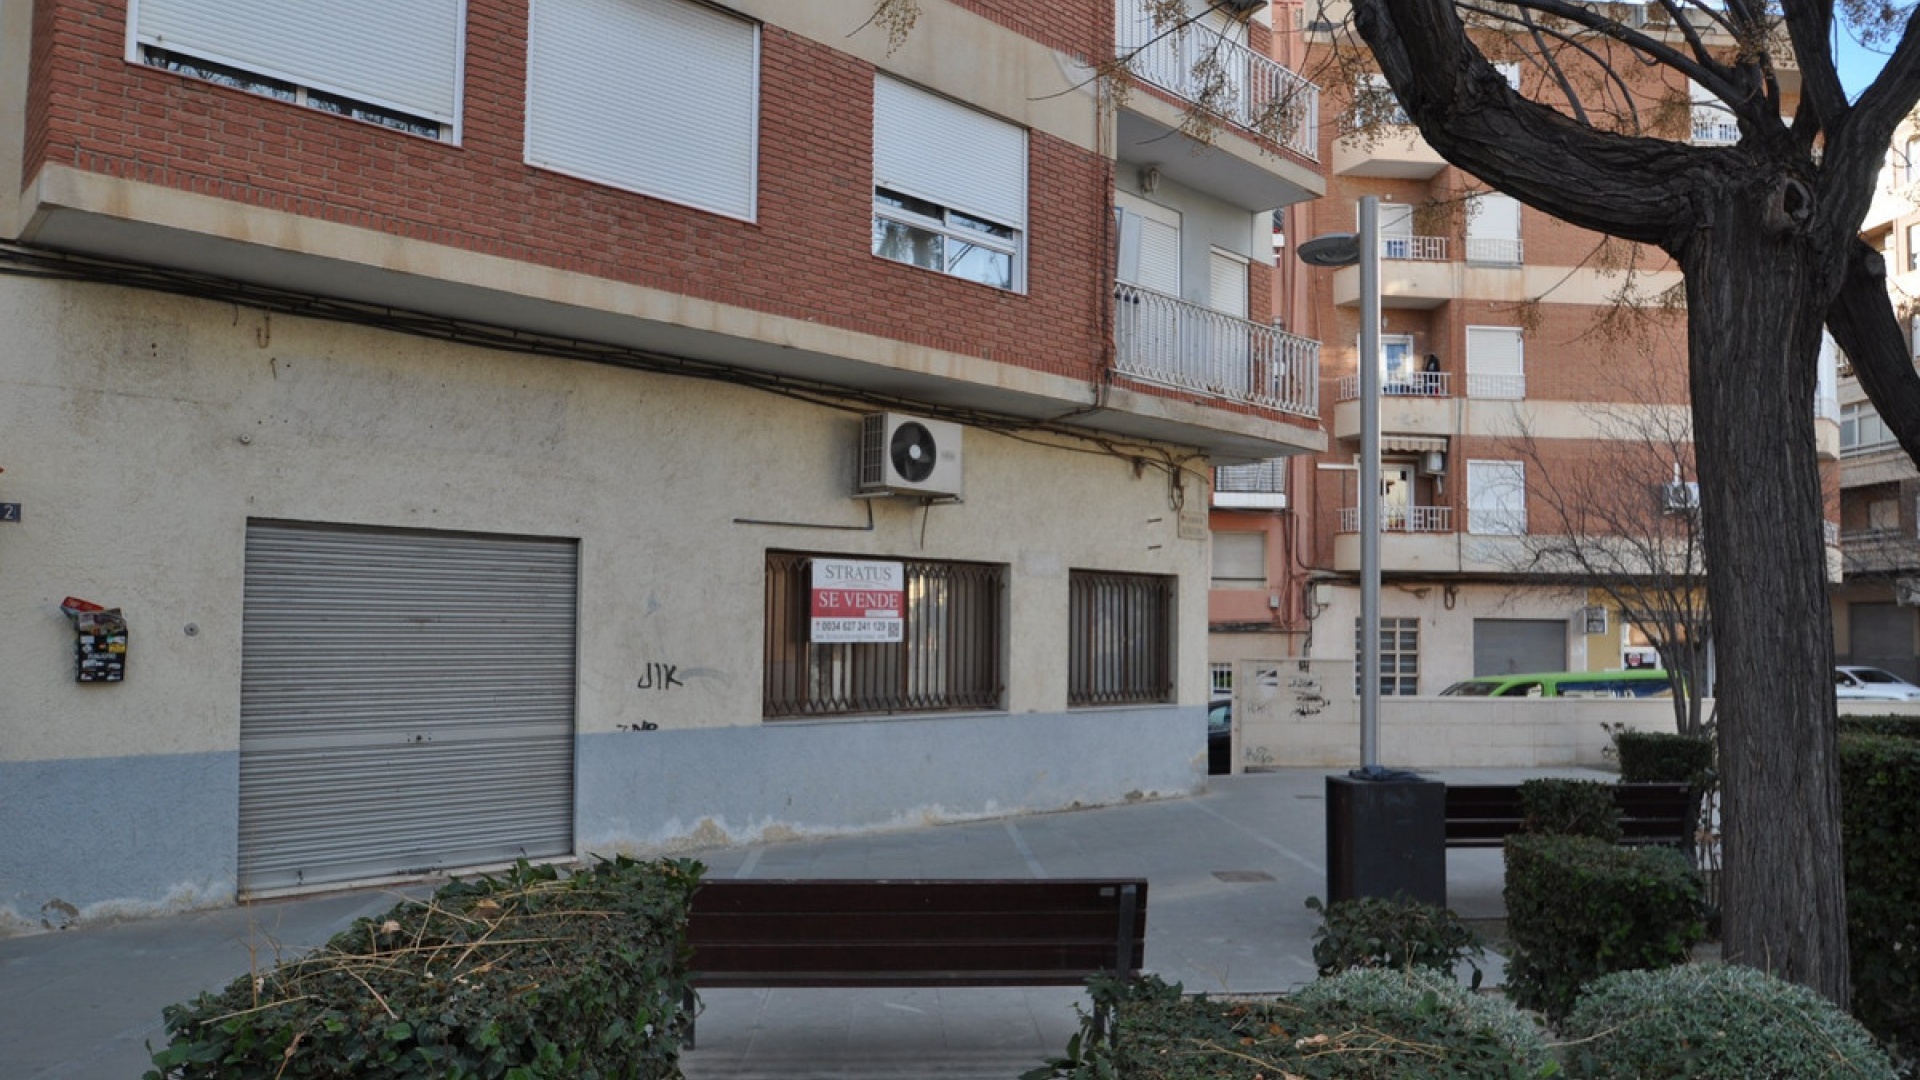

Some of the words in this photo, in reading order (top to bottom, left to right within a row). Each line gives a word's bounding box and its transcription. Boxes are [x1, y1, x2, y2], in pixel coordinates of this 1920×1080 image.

[825, 564, 892, 580] STRATUS
[818, 591, 840, 608] SE
[844, 592, 899, 608] VENDE
[821, 620, 841, 632] 0034
